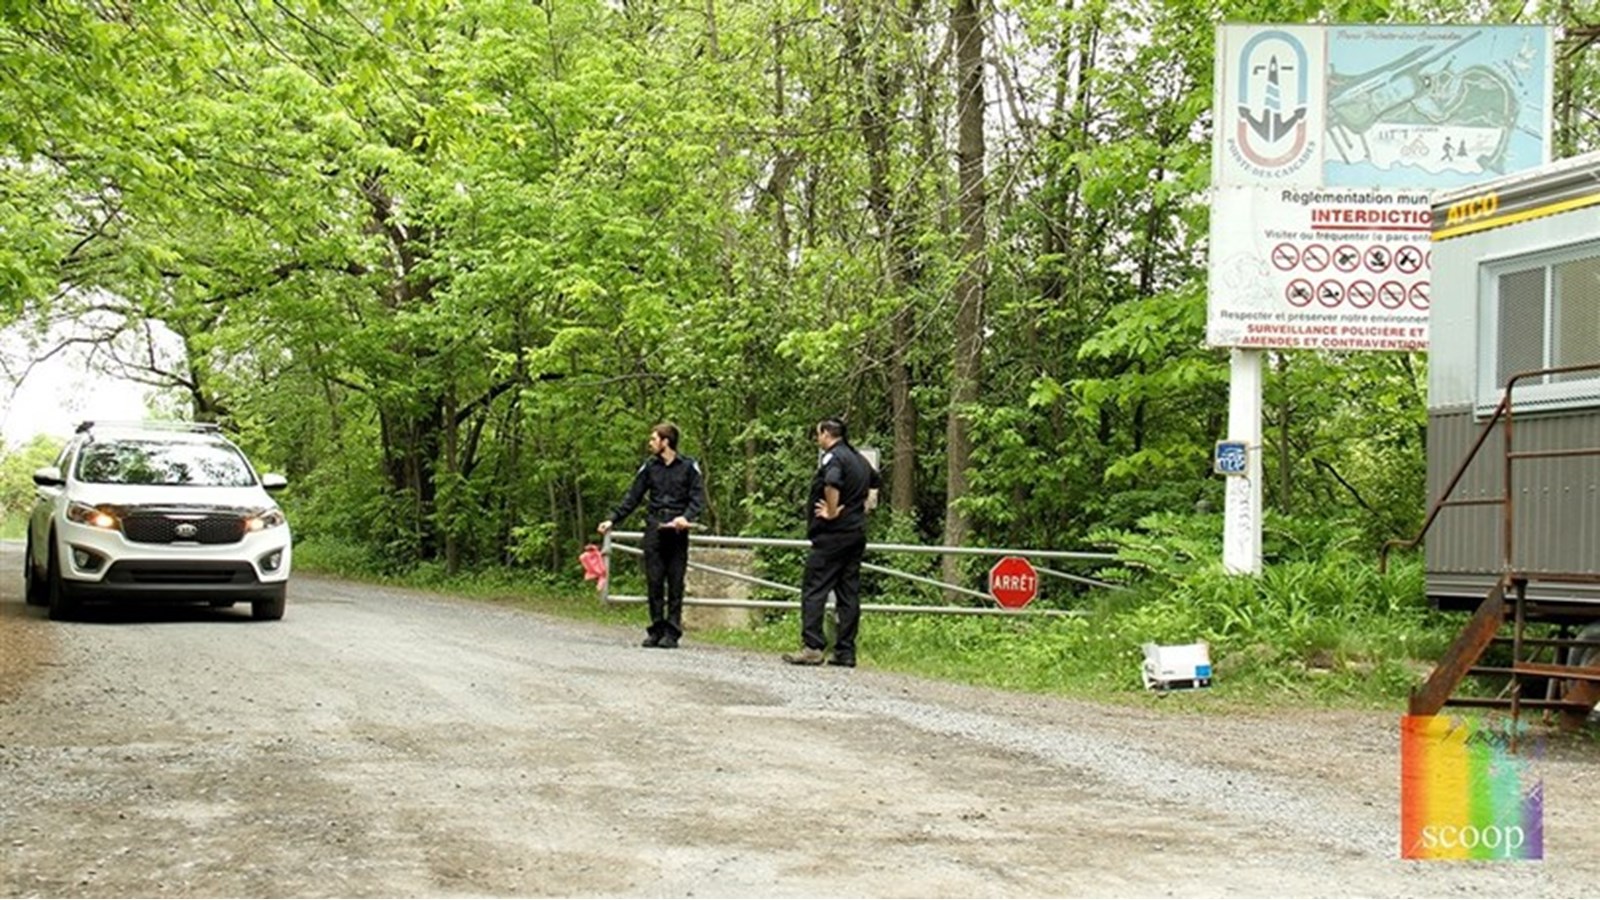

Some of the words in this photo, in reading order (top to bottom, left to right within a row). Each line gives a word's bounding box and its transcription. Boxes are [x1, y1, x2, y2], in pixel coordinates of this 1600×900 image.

[1445, 192, 1498, 227] ATCO
[1264, 230, 1297, 240] Visiter
[1299, 231, 1314, 241] ou
[1385, 234, 1408, 245] parc
[1220, 310, 1273, 321] Respecter
[1275, 312, 1286, 321] et
[1340, 314, 1368, 323] notre
[1247, 324, 1338, 335] SURVEILLANCE
[1409, 328, 1425, 337] ET
[1242, 336, 1300, 346] AMENDES
[1303, 338, 1318, 346] ET
[993, 574, 1035, 592] ARRÊT
